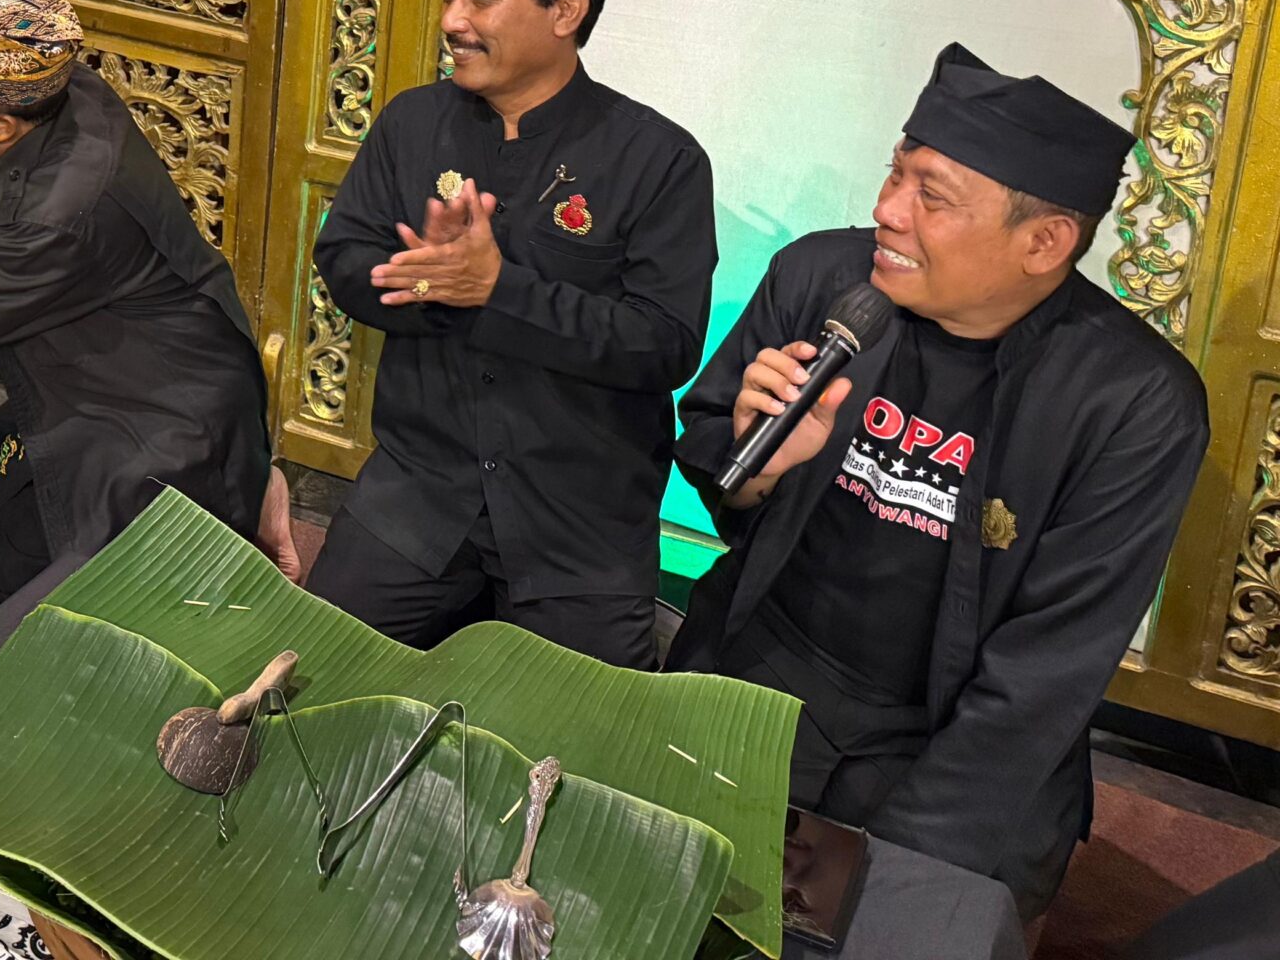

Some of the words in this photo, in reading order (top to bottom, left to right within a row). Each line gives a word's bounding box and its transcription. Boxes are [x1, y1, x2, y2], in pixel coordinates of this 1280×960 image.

[882, 480, 925, 502] Pelestari
[925, 491, 944, 511] Adat
[946, 498, 956, 515] Tr
